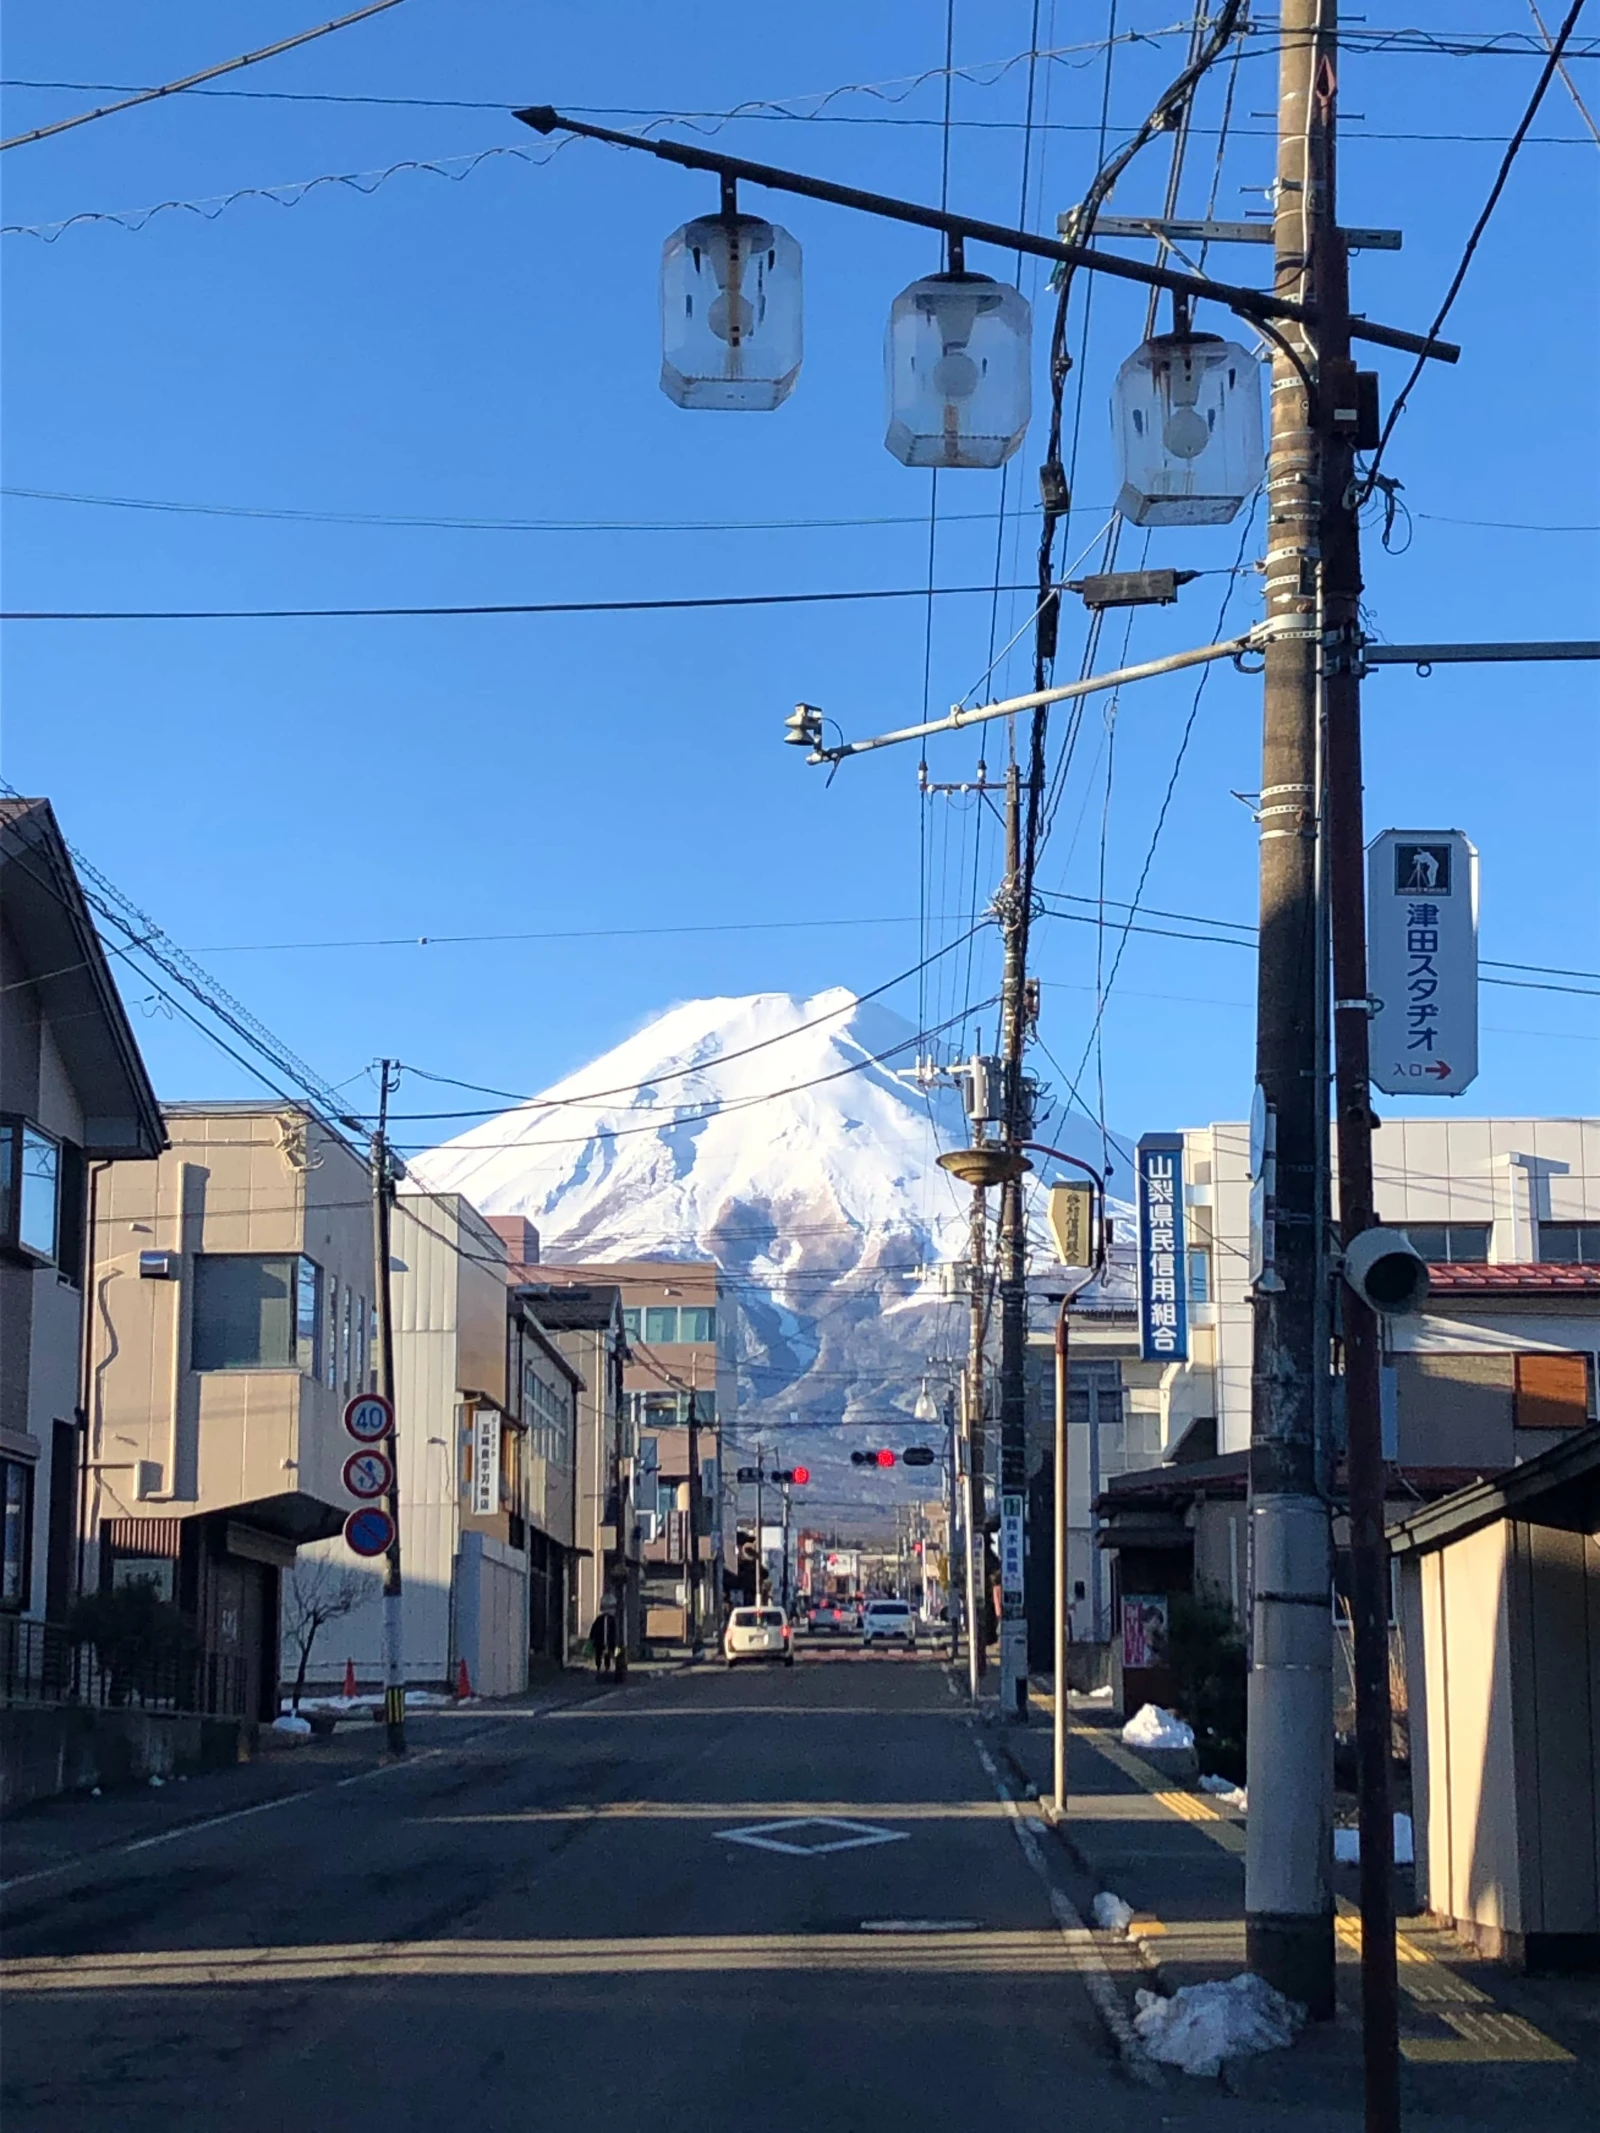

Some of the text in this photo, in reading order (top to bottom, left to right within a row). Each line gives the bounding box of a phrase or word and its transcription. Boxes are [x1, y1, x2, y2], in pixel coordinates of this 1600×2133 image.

[1406, 903, 1439, 1050] 津田スタヂオ
[1393, 1062, 1422, 1077] 入口
[1147, 1154, 1177, 1352] 山梨県民信用組合
[356, 1407, 383, 1429] 40
